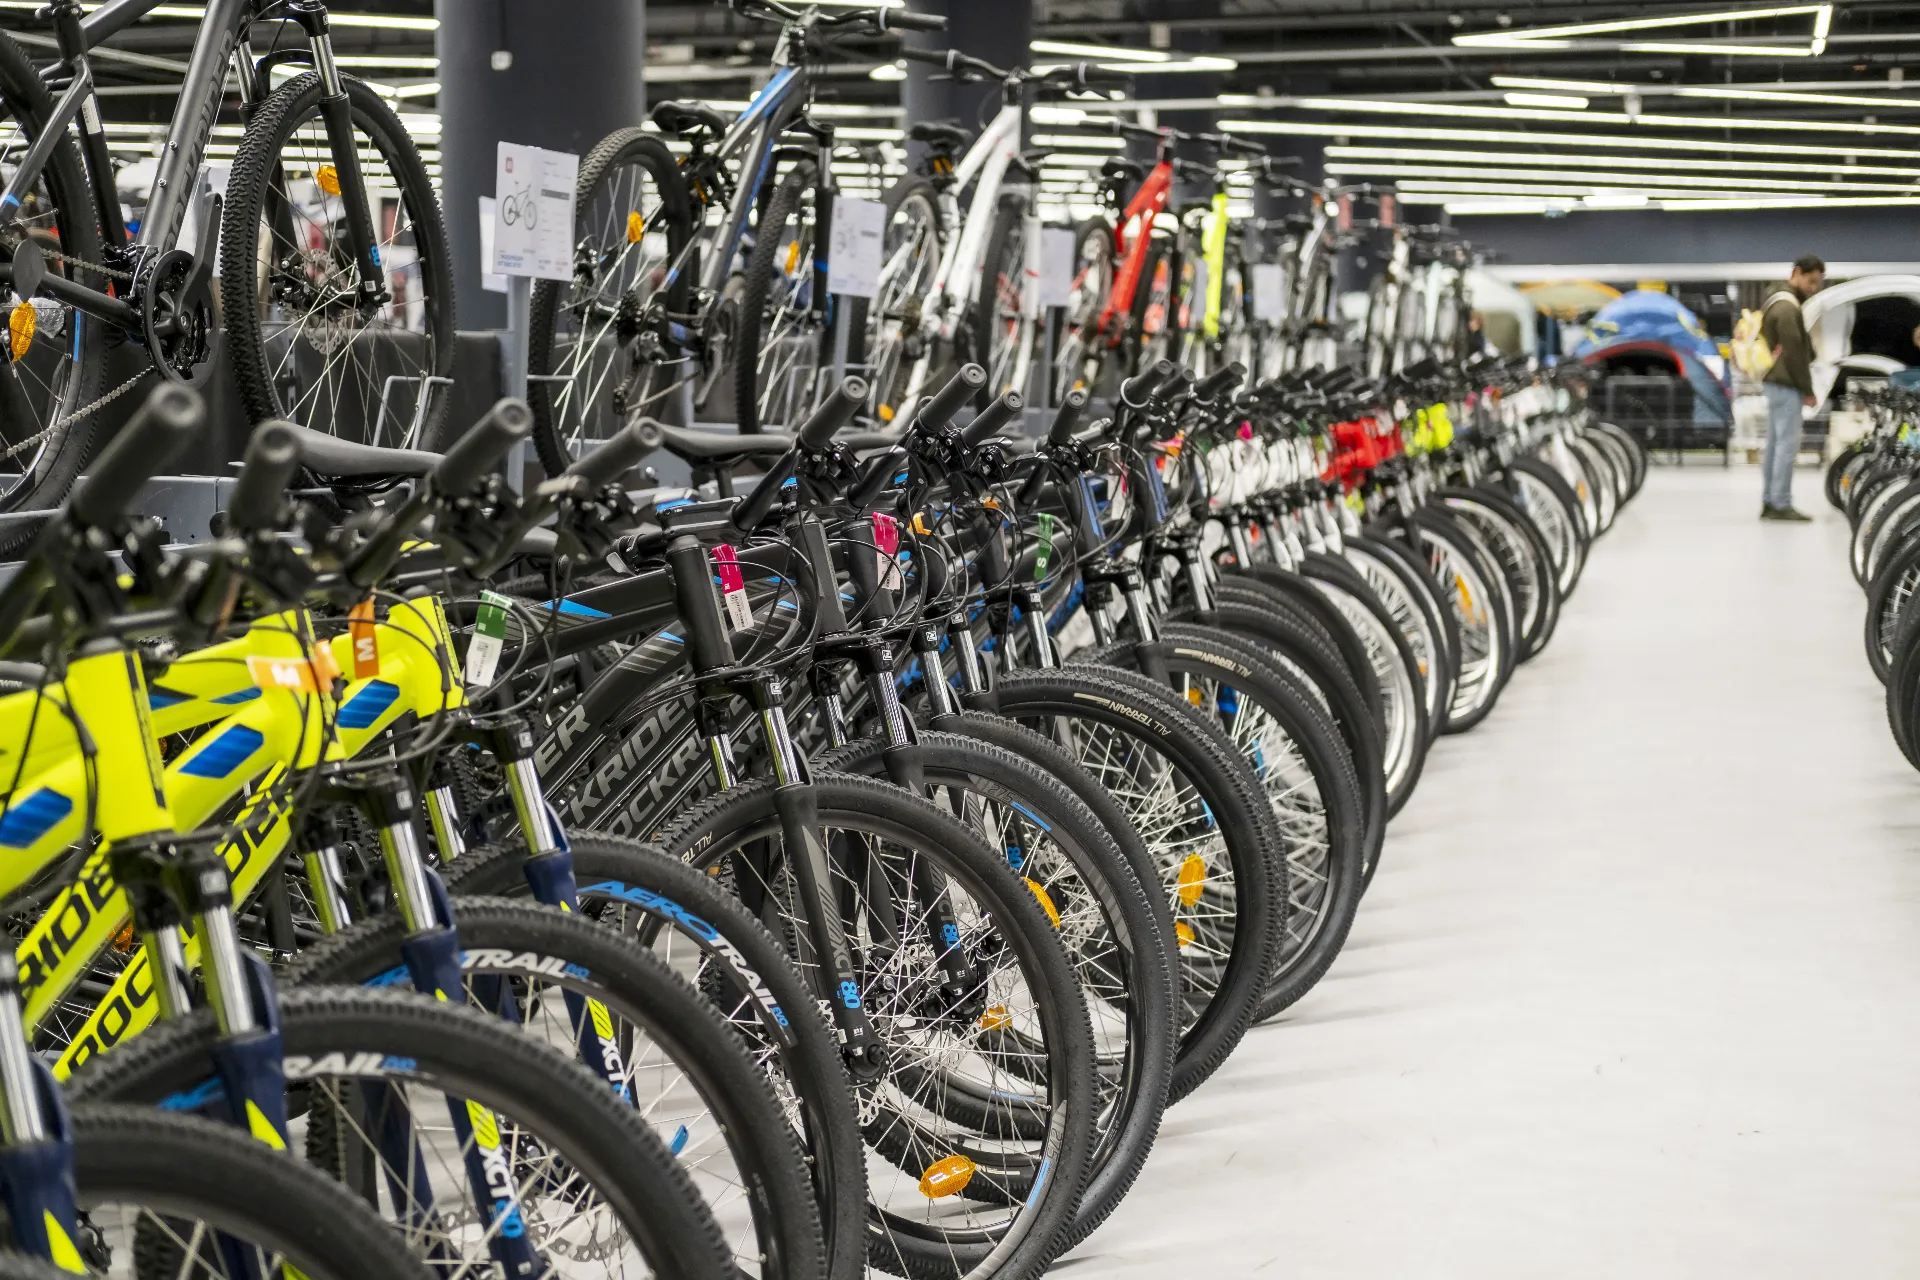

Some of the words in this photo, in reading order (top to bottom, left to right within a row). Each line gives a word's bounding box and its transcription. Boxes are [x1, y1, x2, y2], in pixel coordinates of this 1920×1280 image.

[1036, 556, 1047, 569] S
[355, 637, 375, 662] M
[270, 663, 301, 687] M
[1108, 701, 1153, 727] TERRAIN
[1153, 720, 1172, 736] ALL
[694, 830, 713, 852] ALL
[680, 847, 696, 865] TE
[460, 948, 568, 979] TRAIL
[840, 981, 861, 1009] 80
[770, 1006, 789, 1027] EVO
[597, 1035, 626, 1082] XCT
[477, 1143, 518, 1201] XCT
